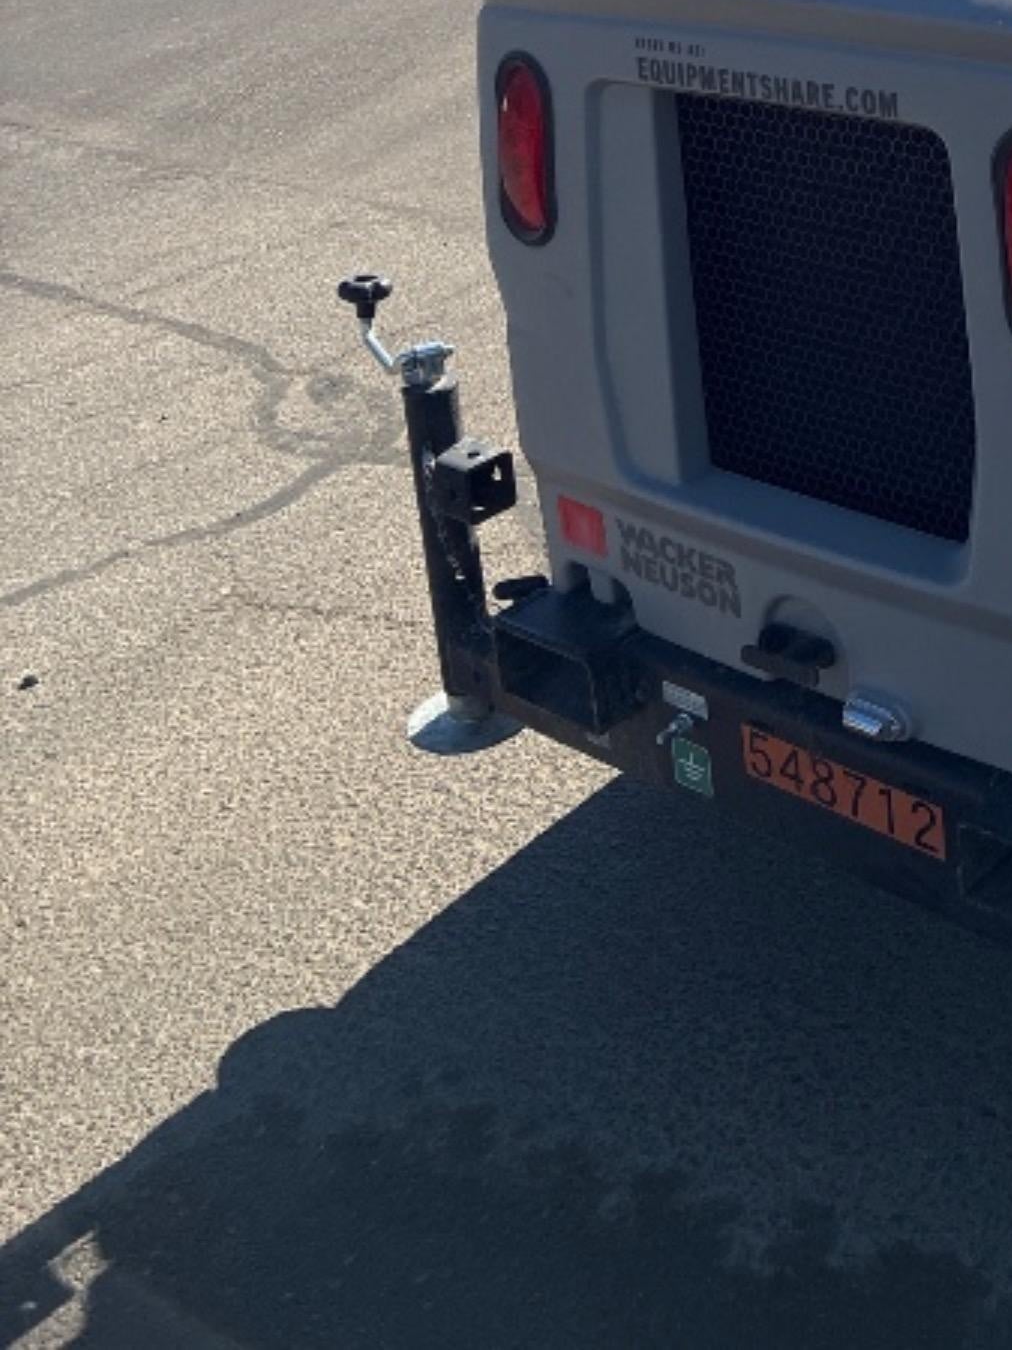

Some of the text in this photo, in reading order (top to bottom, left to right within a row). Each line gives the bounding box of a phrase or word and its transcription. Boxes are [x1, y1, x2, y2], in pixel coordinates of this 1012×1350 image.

[637, 57, 898, 117] EQUIPMENTSHARE.COM
[616, 518, 739, 588] WACKER
[621, 544, 742, 619] NEUSON
[748, 728, 940, 853] 548712
